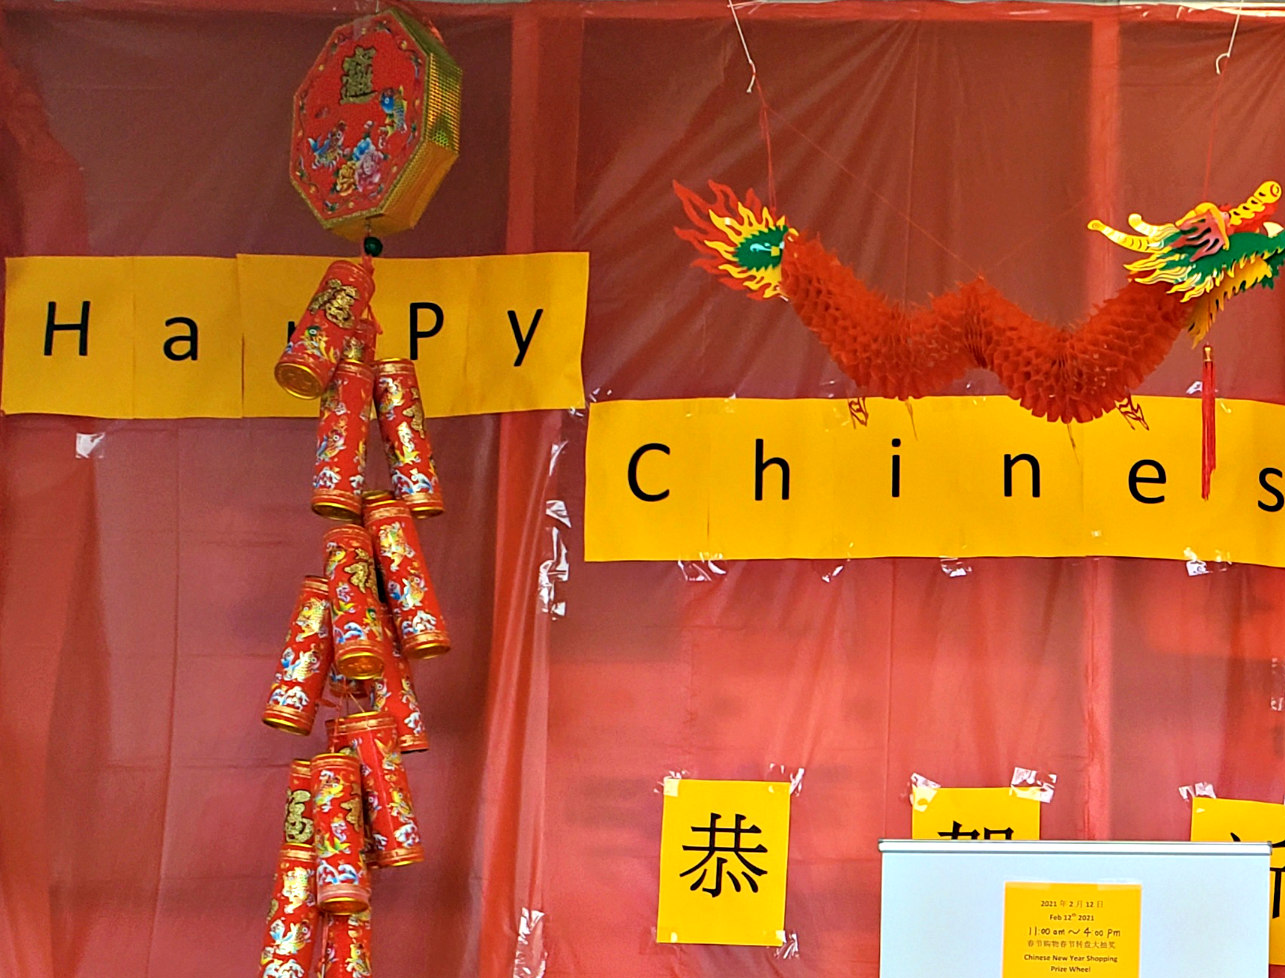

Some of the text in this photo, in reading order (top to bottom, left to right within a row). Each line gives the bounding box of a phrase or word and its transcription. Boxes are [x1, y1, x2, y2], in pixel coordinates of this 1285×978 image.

[1078, 914, 1095, 922] 2021
[1023, 953, 1051, 962] Chinese
[1052, 954, 1068, 962] New
[1086, 955, 1118, 963] Shopping
[1050, 965, 1092, 973] Prize Wheel
